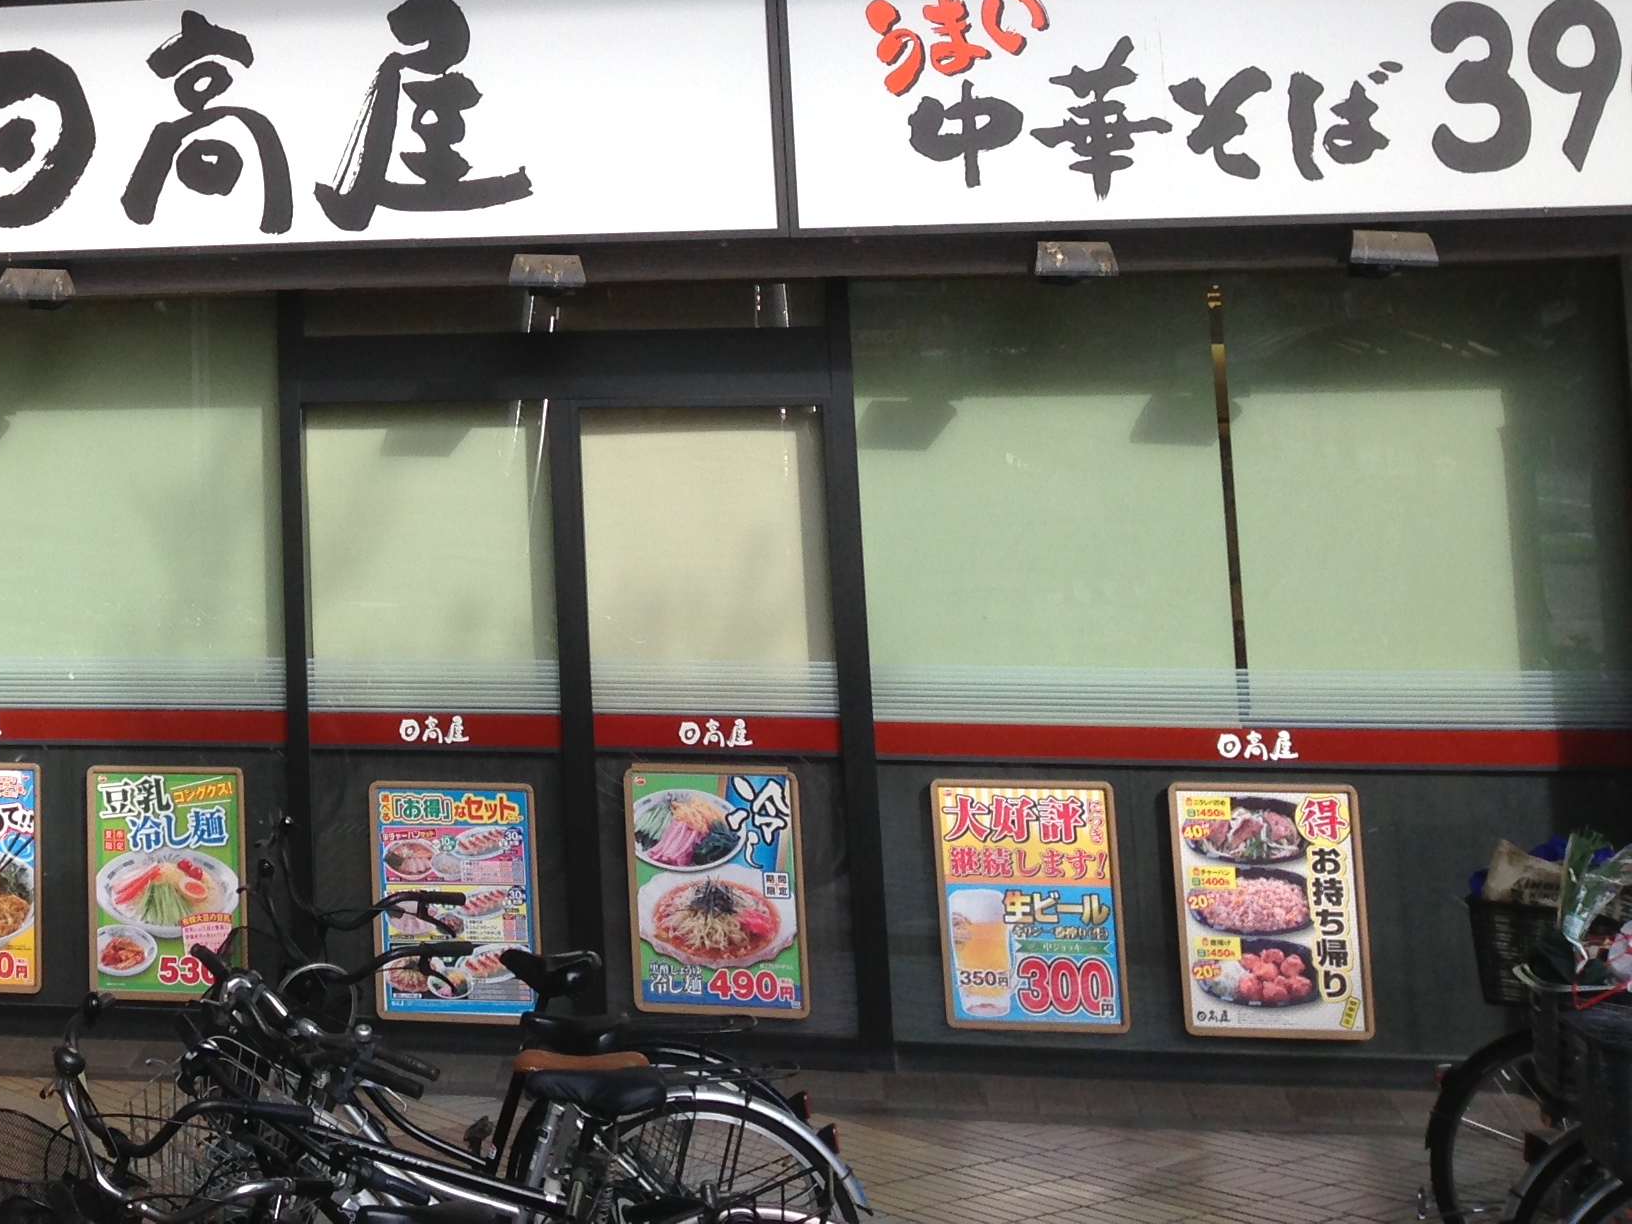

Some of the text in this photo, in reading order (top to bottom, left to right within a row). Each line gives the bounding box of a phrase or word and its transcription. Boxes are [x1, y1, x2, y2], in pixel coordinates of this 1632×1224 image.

[907, 35, 1406, 201] 中華そば
[399, 716, 470, 744] 日高屋
[679, 718, 753, 747] 日高屋
[1217, 731, 1299, 761] 日高屋
[98, 776, 172, 817] 豆乳
[128, 807, 227, 851] 冷し麺
[943, 795, 1085, 843] 大好評
[1301, 798, 1348, 840] 得
[1004, 890, 1111, 925] 生ビール
[1311, 847, 1348, 998] お持ち帰り
[650, 975, 703, 994] 冷し麺
